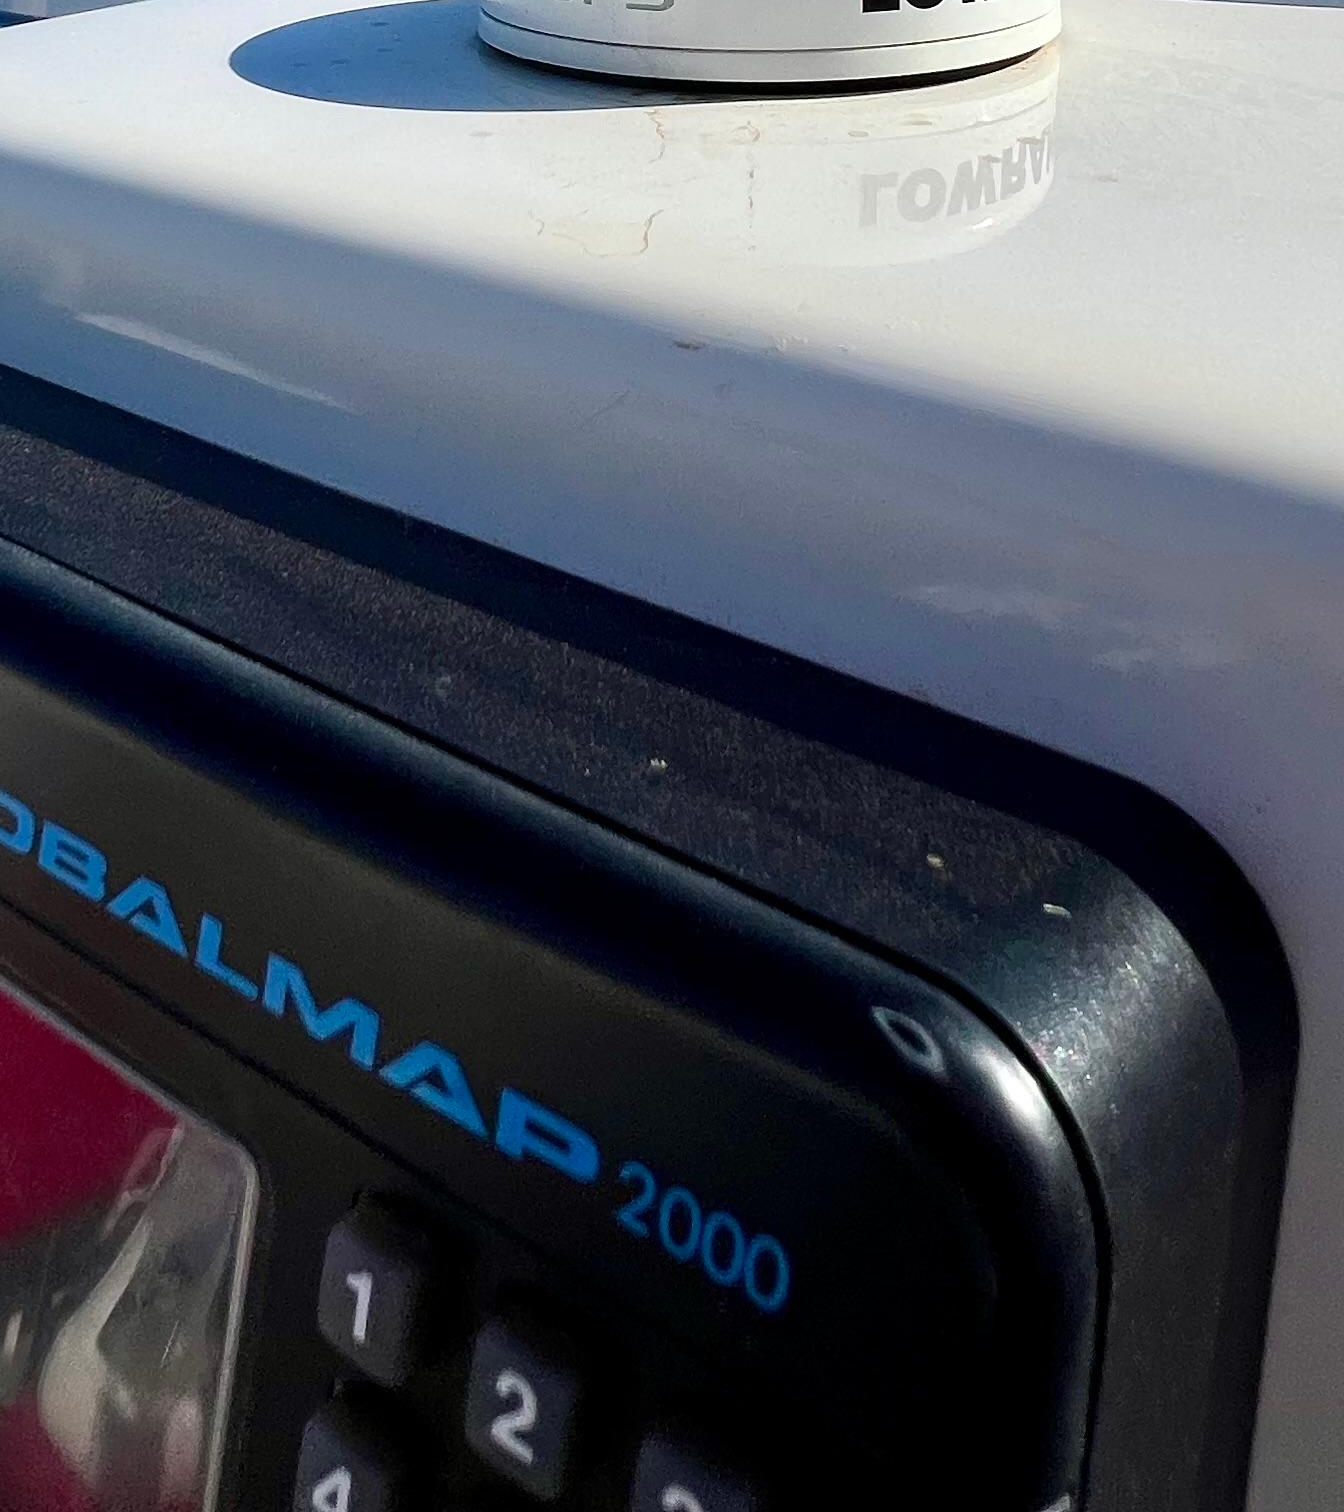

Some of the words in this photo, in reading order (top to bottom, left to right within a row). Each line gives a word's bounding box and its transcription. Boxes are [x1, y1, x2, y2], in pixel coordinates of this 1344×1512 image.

[614, 1160, 790, 1311] 2000
[346, 1272, 373, 1344] 1
[491, 1367, 537, 1464] 2
